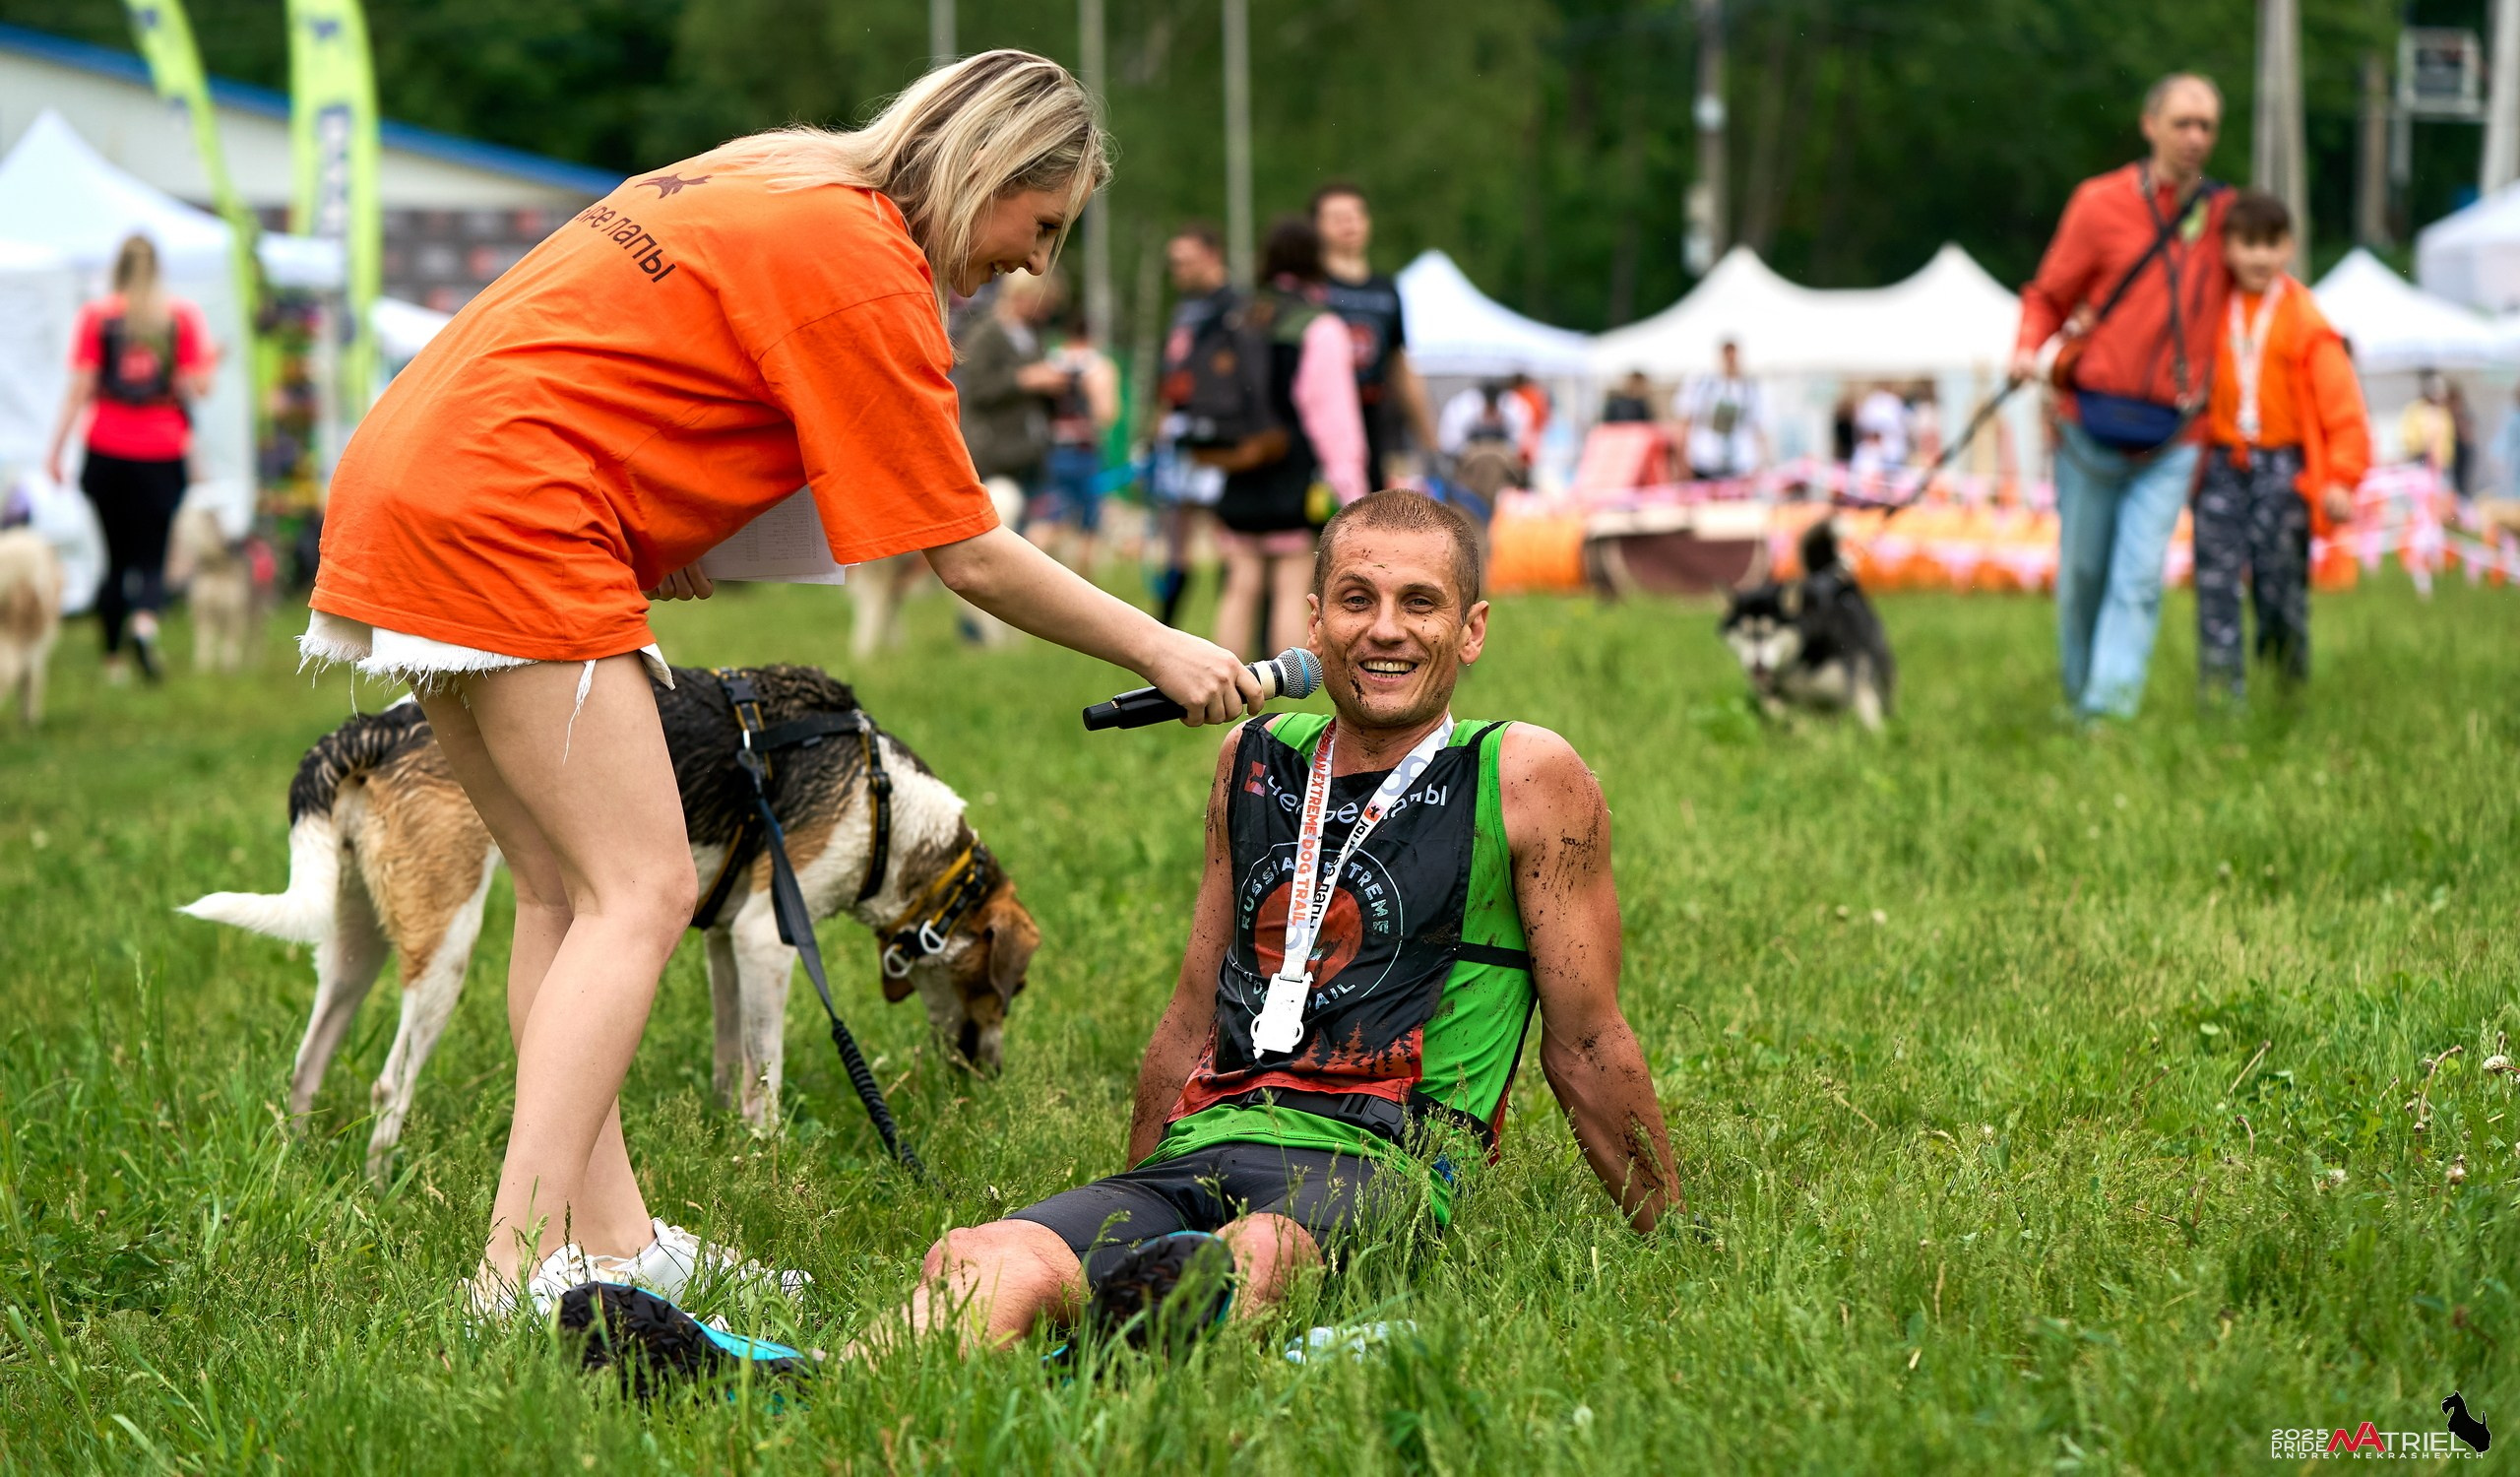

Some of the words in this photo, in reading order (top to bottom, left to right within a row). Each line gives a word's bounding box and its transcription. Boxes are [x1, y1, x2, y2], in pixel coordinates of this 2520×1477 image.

[600, 216, 676, 283] лапы
[1304, 772, 1326, 836] EXTREME
[1383, 783, 1447, 820] апы
[1298, 839, 1315, 874] DOG
[1241, 857, 1295, 931] RUSSIA
[1323, 862, 1389, 934] ETREME
[1292, 878, 1310, 926] TRAIL
